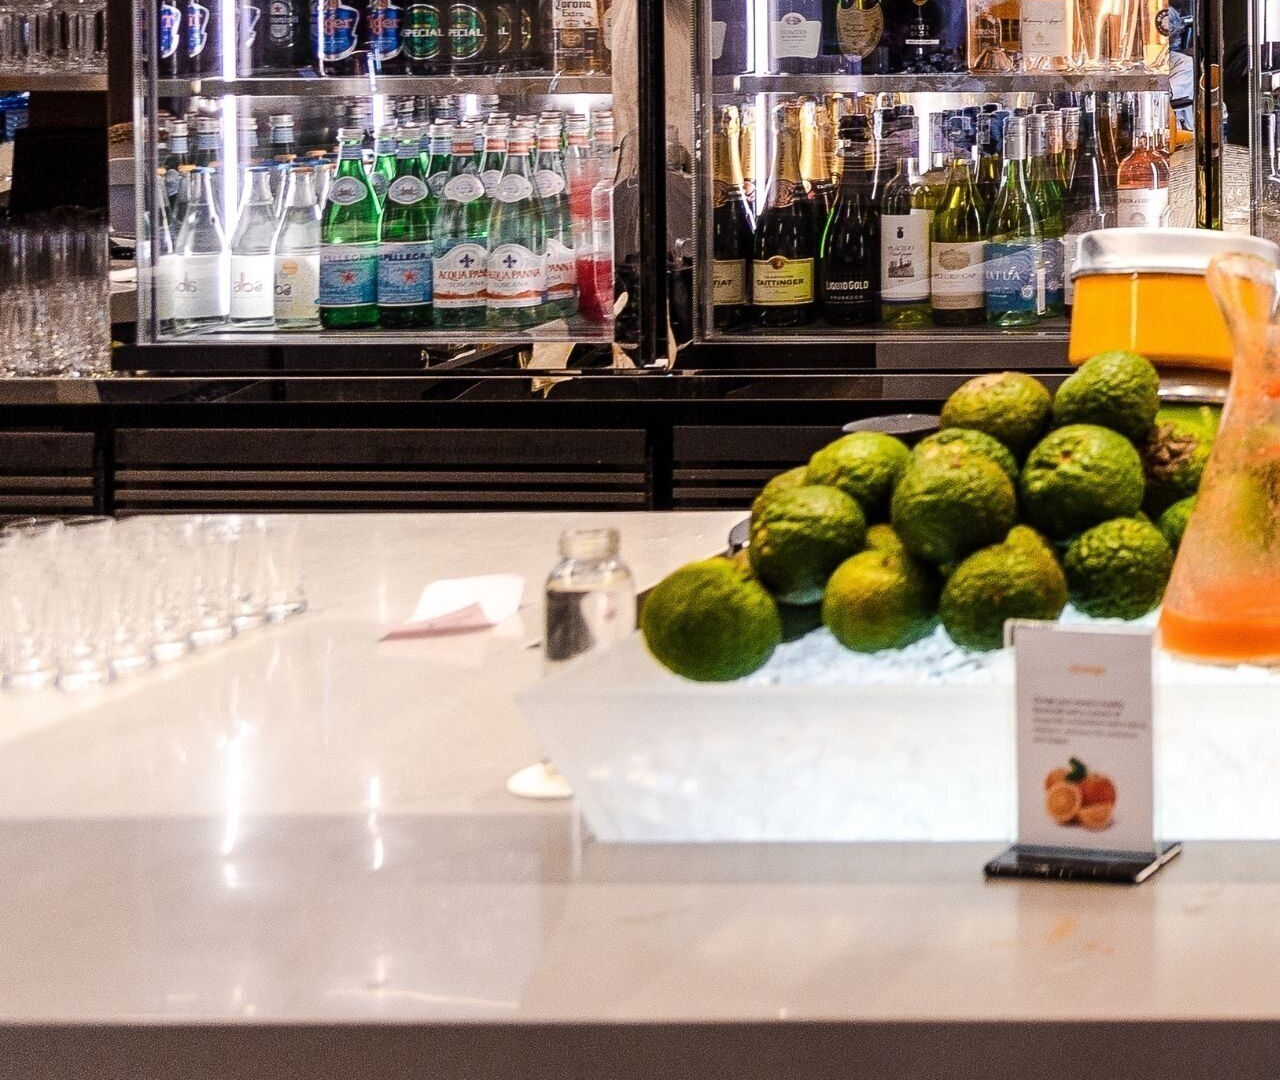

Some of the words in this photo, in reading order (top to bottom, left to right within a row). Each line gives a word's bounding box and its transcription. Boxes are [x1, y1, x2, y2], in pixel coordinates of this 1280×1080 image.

[561, 9, 585, 18] Extra
[448, 28, 485, 38] PECIAL
[848, 280, 869, 290] GOLD
